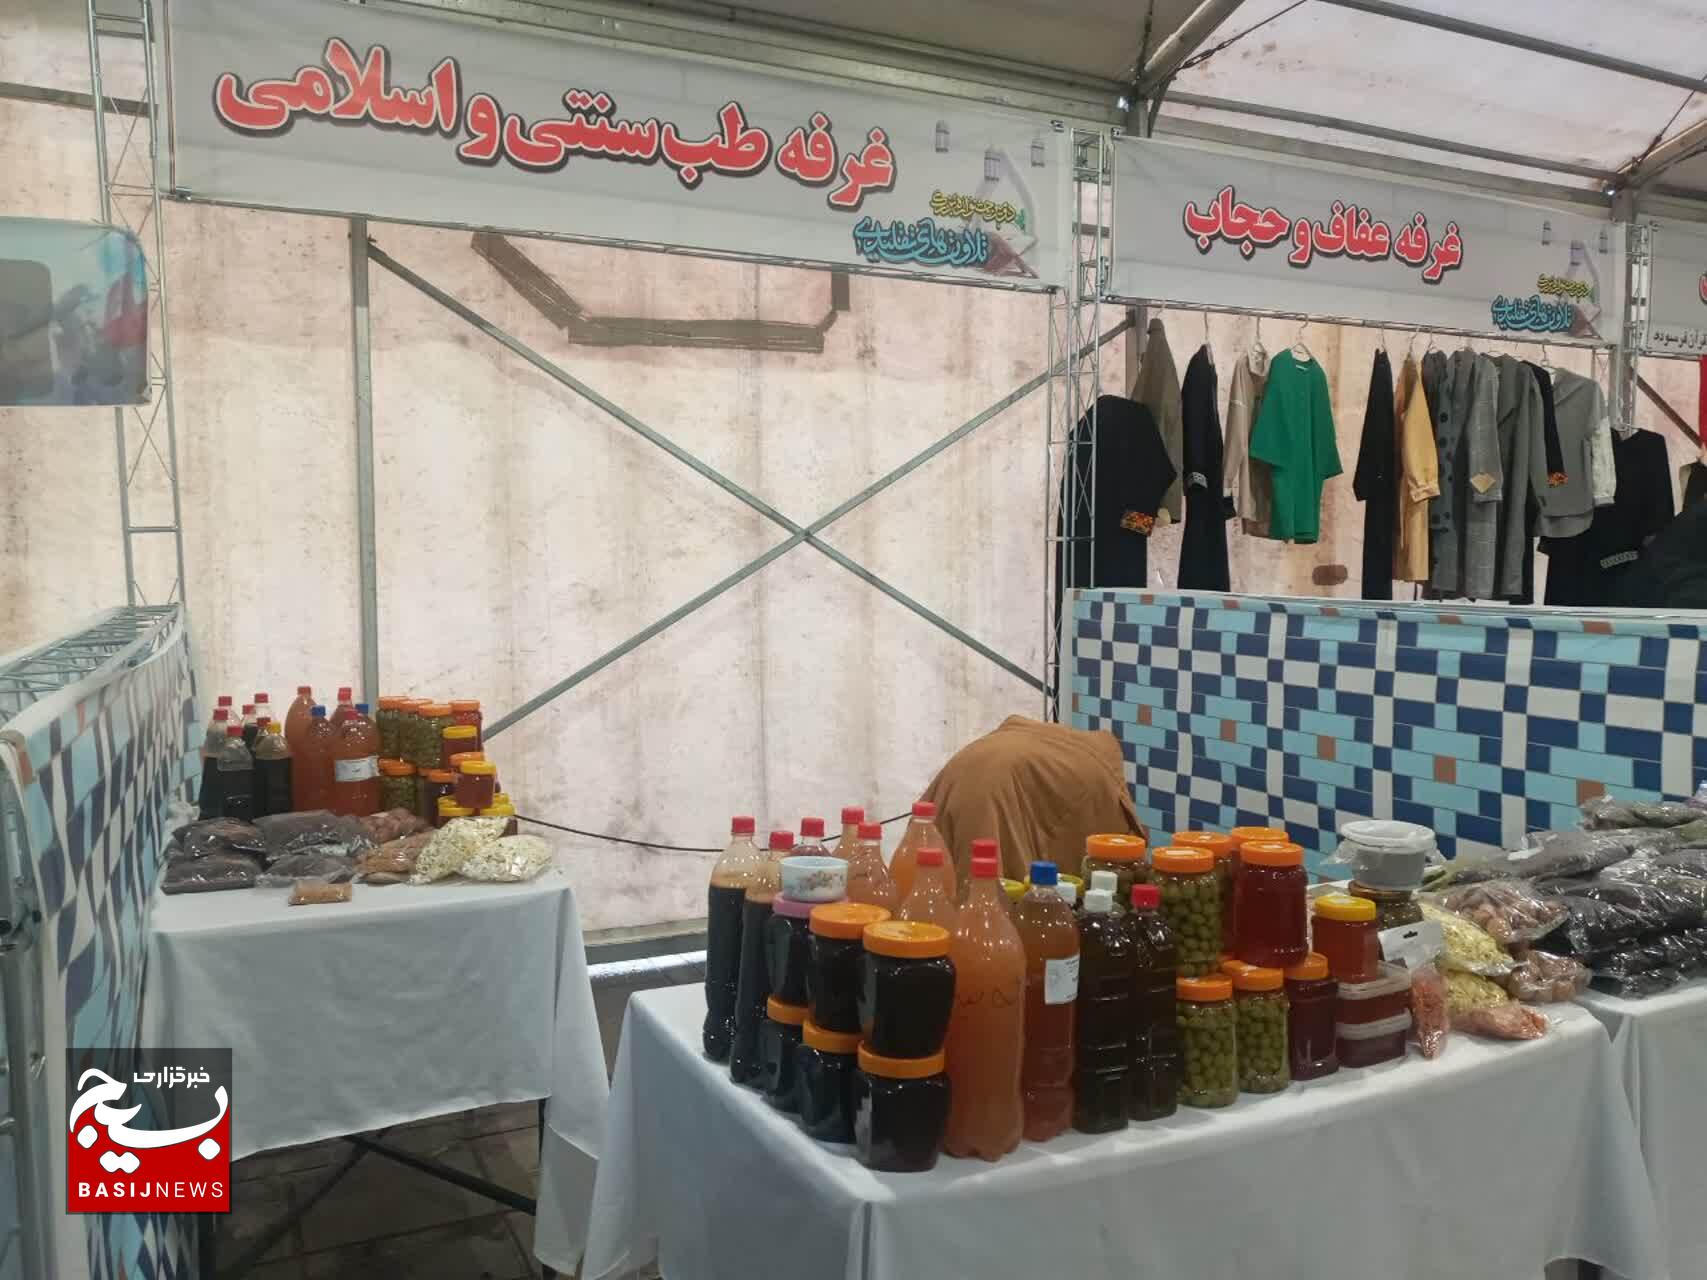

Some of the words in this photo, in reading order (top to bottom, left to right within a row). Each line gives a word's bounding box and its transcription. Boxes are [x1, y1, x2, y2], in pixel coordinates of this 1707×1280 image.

[215, 37, 458, 132] اسلامی
[458, 93, 501, 160] و
[502, 89, 660, 168] سنتی
[659, 101, 771, 184] طب
[777, 112, 897, 207] غرفه
[1183, 185, 1291, 256] حجاب
[1288, 217, 1312, 264] و
[1310, 200, 1392, 257] عفاف
[1393, 212, 1463, 280] غرفه
